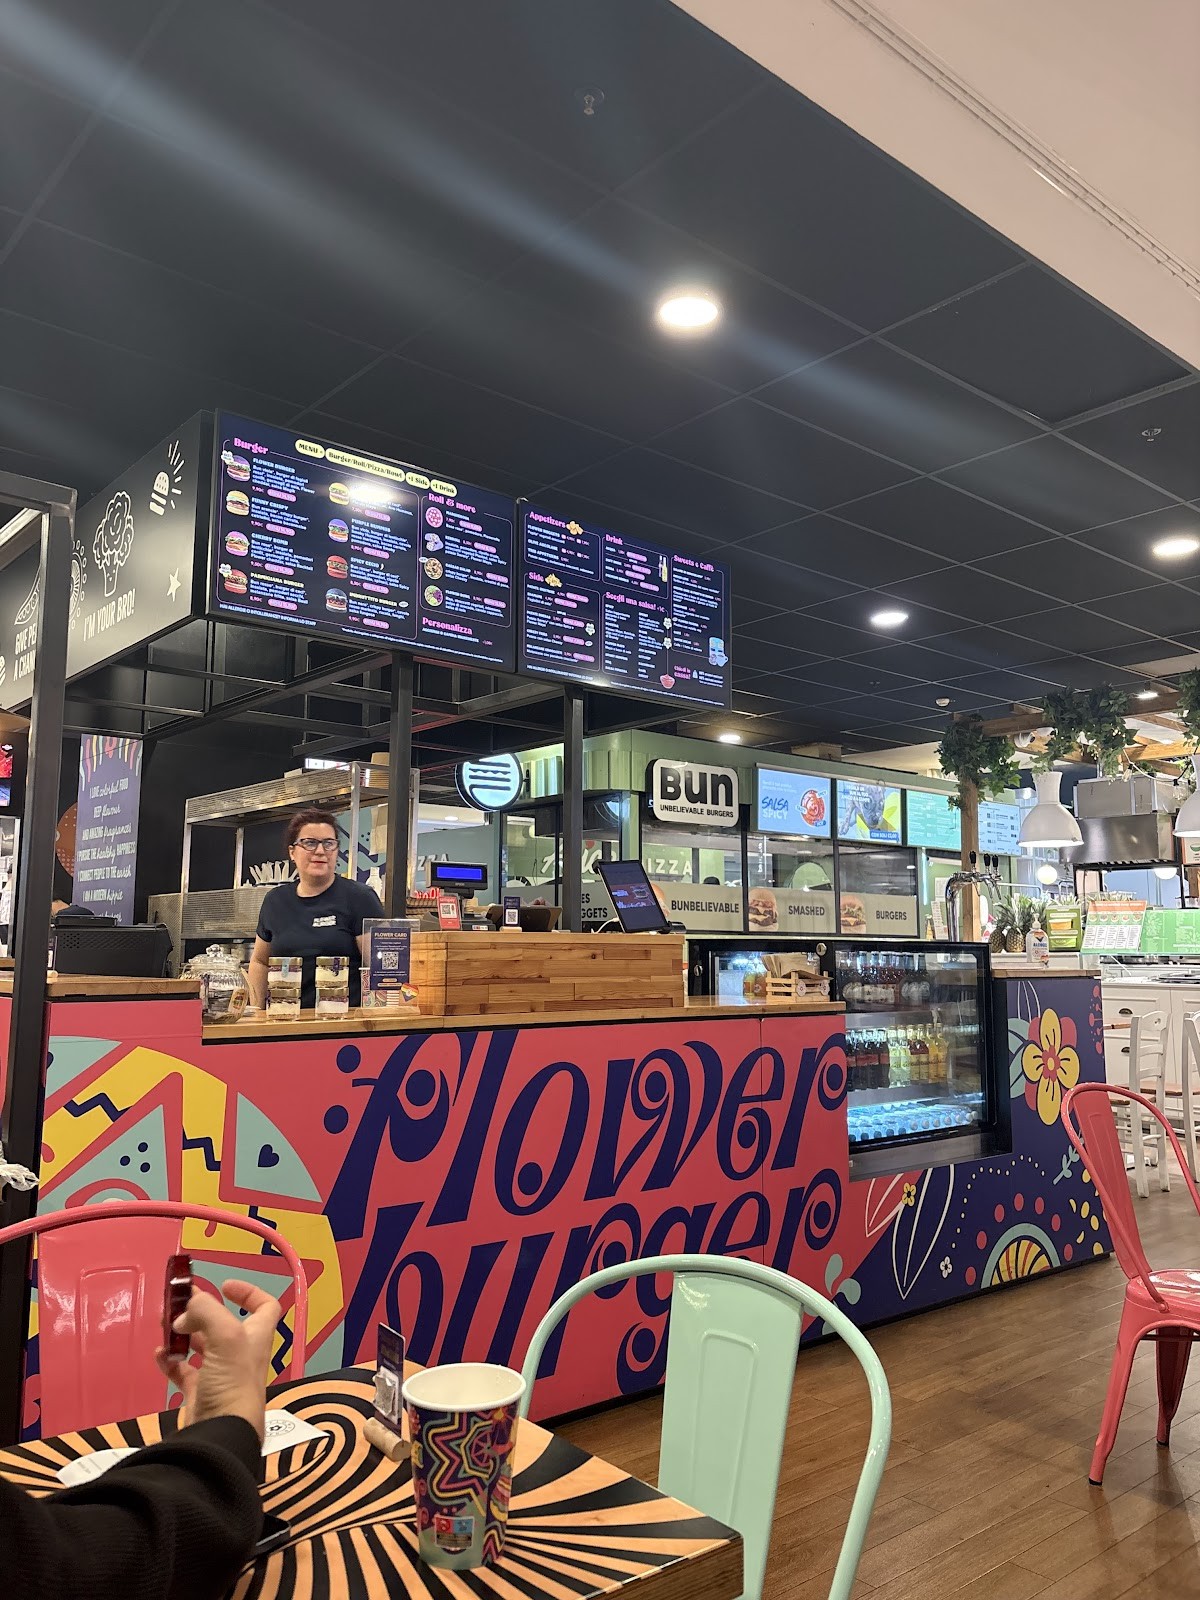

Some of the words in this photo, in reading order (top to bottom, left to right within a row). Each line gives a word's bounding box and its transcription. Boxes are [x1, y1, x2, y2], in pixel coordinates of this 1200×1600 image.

[234, 438, 268, 454] Burger
[298, 443, 318, 454] MENU
[415, 478, 427, 486] Side
[440, 484, 454, 493] Drink
[428, 493, 444, 504] Roll
[456, 502, 476, 513] more
[530, 512, 565, 528] Appetizers
[606, 534, 623, 545] Drink
[674, 555, 694, 566] Sweets
[529, 572, 544, 582] Side
[606, 592, 624, 602] Scegli
[626, 598, 637, 606] una
[84, 618, 95, 641] I'M
[98, 604, 116, 634] YOUR
[117, 588, 136, 624] BRO!
[422, 617, 472, 635] Personalizza
[120, 778, 128, 790] FOOD
[762, 796, 788, 811] SALSA
[660, 804, 704, 815] UNBELIEVABLE
[706, 809, 733, 818] BURGERS
[762, 808, 788, 819] SPICY
[89, 826, 104, 839] AMAZING
[97, 846, 116, 864] healthy
[117, 841, 136, 856] HAPPINESS
[94, 868, 105, 880] PEOPLE
[106, 867, 110, 879] TO
[117, 865, 132, 878] earth
[94, 889, 107, 901] MODERN
[107, 889, 123, 905] hippie
[671, 900, 739, 913] BUNBELIEVABLE
[788, 905, 825, 916] SMASHED
[876, 910, 907, 921] BURGERS
